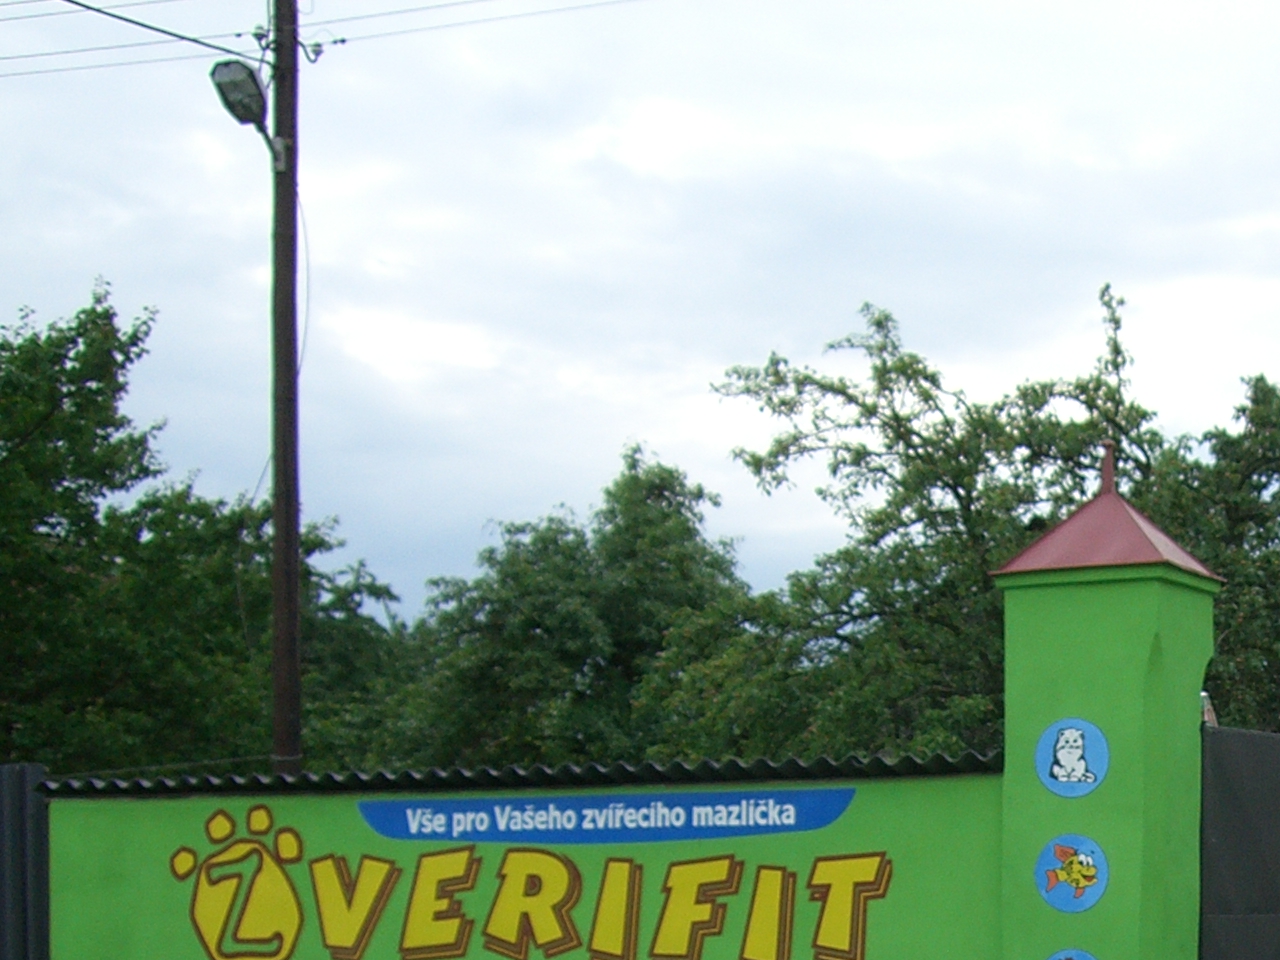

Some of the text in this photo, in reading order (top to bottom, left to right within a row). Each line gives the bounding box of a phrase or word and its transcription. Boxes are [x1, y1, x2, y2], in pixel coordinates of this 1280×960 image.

[406, 798, 796, 838] Vše pro Vašeho zvířecího mazlíčka
